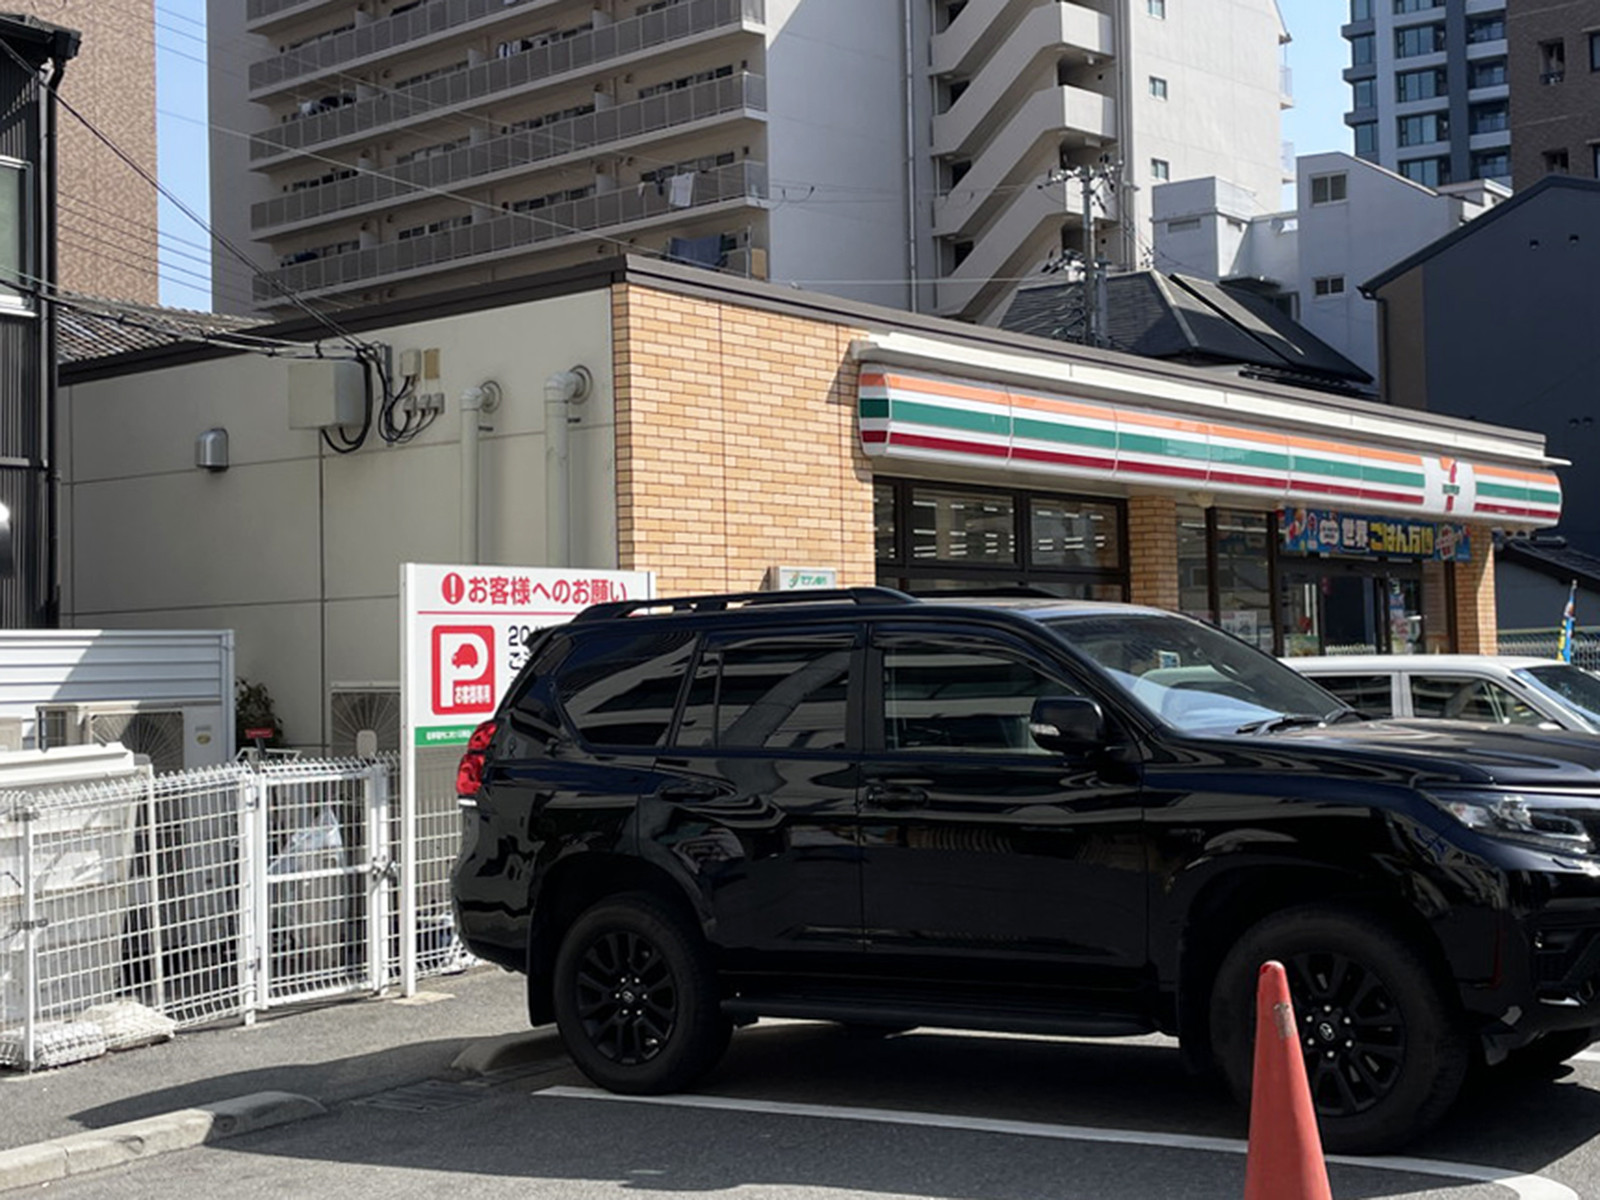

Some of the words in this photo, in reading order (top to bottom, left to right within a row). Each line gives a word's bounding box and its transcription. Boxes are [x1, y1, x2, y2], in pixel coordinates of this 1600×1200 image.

[468, 576, 627, 606] お客様へのお願い
